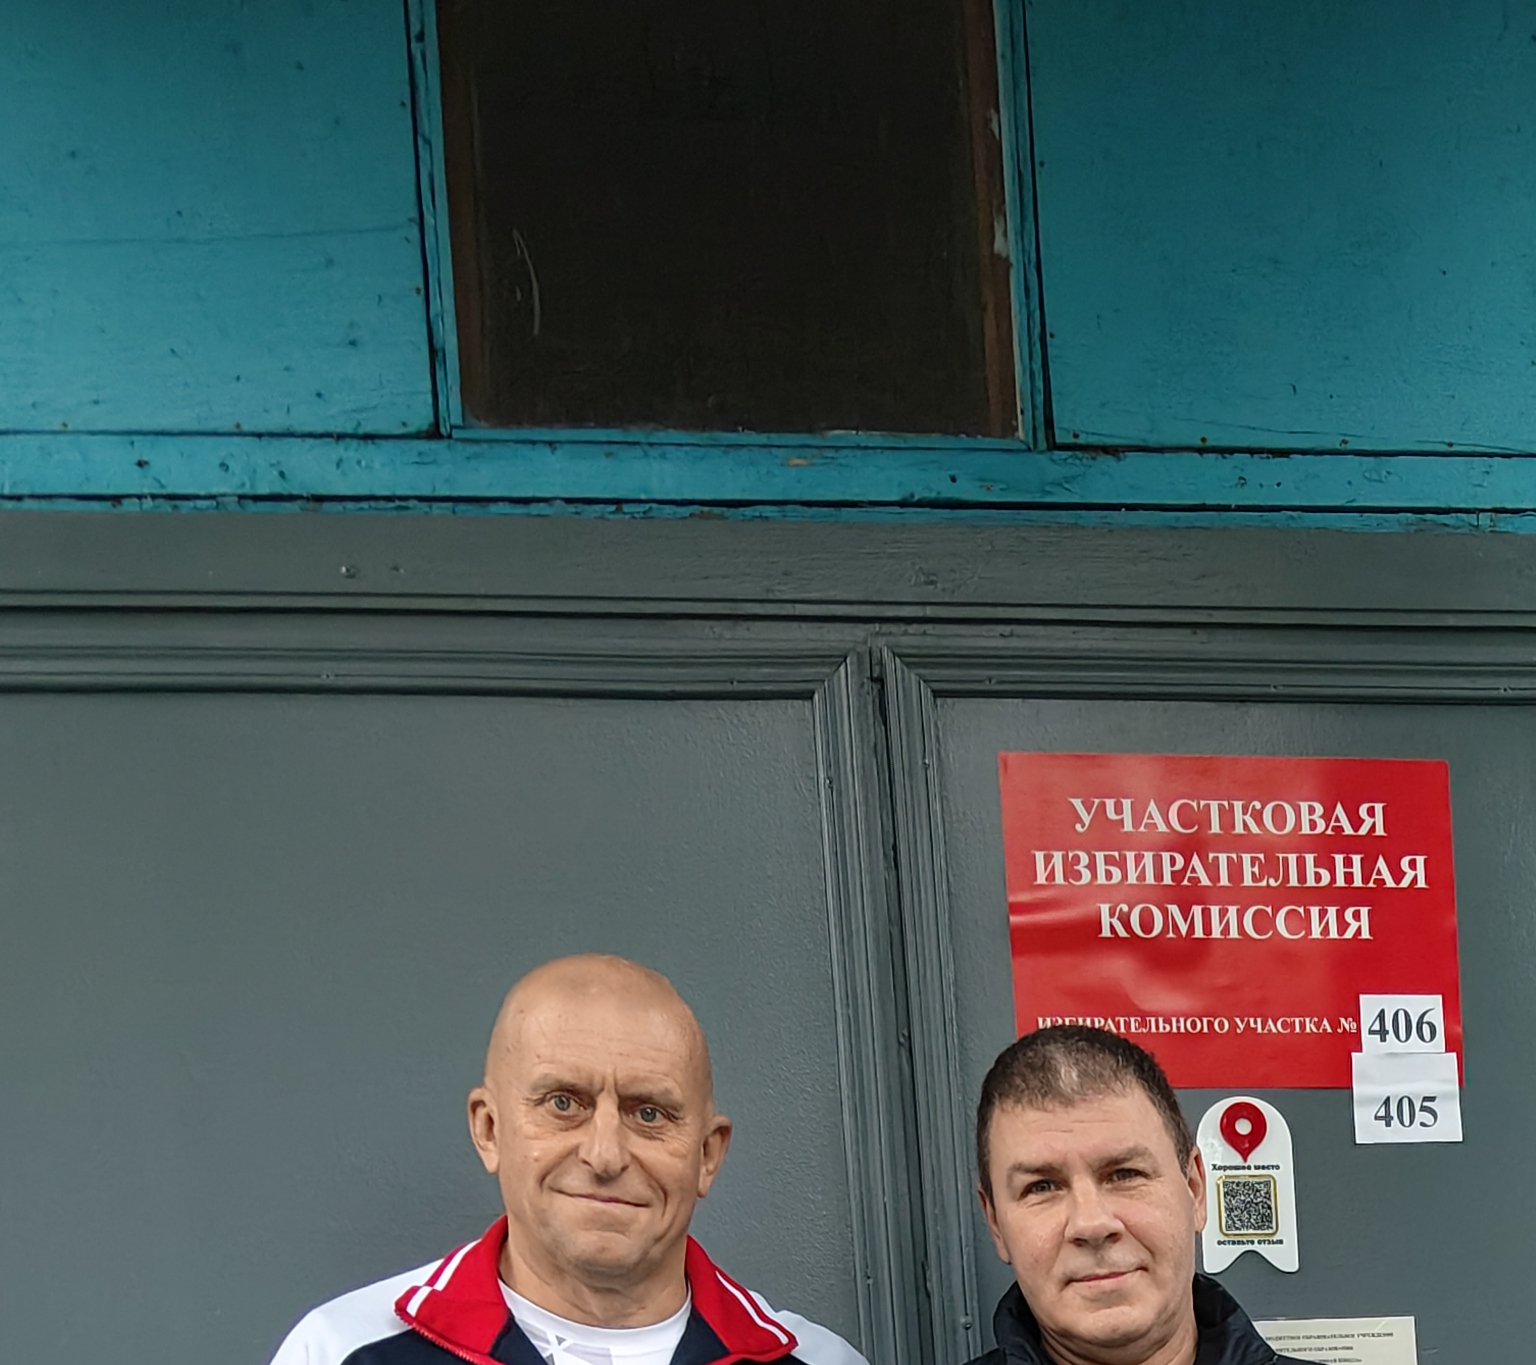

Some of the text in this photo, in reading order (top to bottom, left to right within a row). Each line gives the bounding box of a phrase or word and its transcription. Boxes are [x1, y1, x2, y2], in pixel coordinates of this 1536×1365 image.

[1067, 797, 1388, 836] УЧАСТКОВАЯ
[1032, 849, 1430, 889] ИЗБИРАТЕЛЬНАЯ
[1097, 902, 1374, 941] КОМИССИЯ
[1234, 1016, 1332, 1035] УЧАСТКА
[1336, 1017, 1358, 1035] №
[1366, 1007, 1439, 1045] 406
[1373, 1094, 1440, 1129] 405
